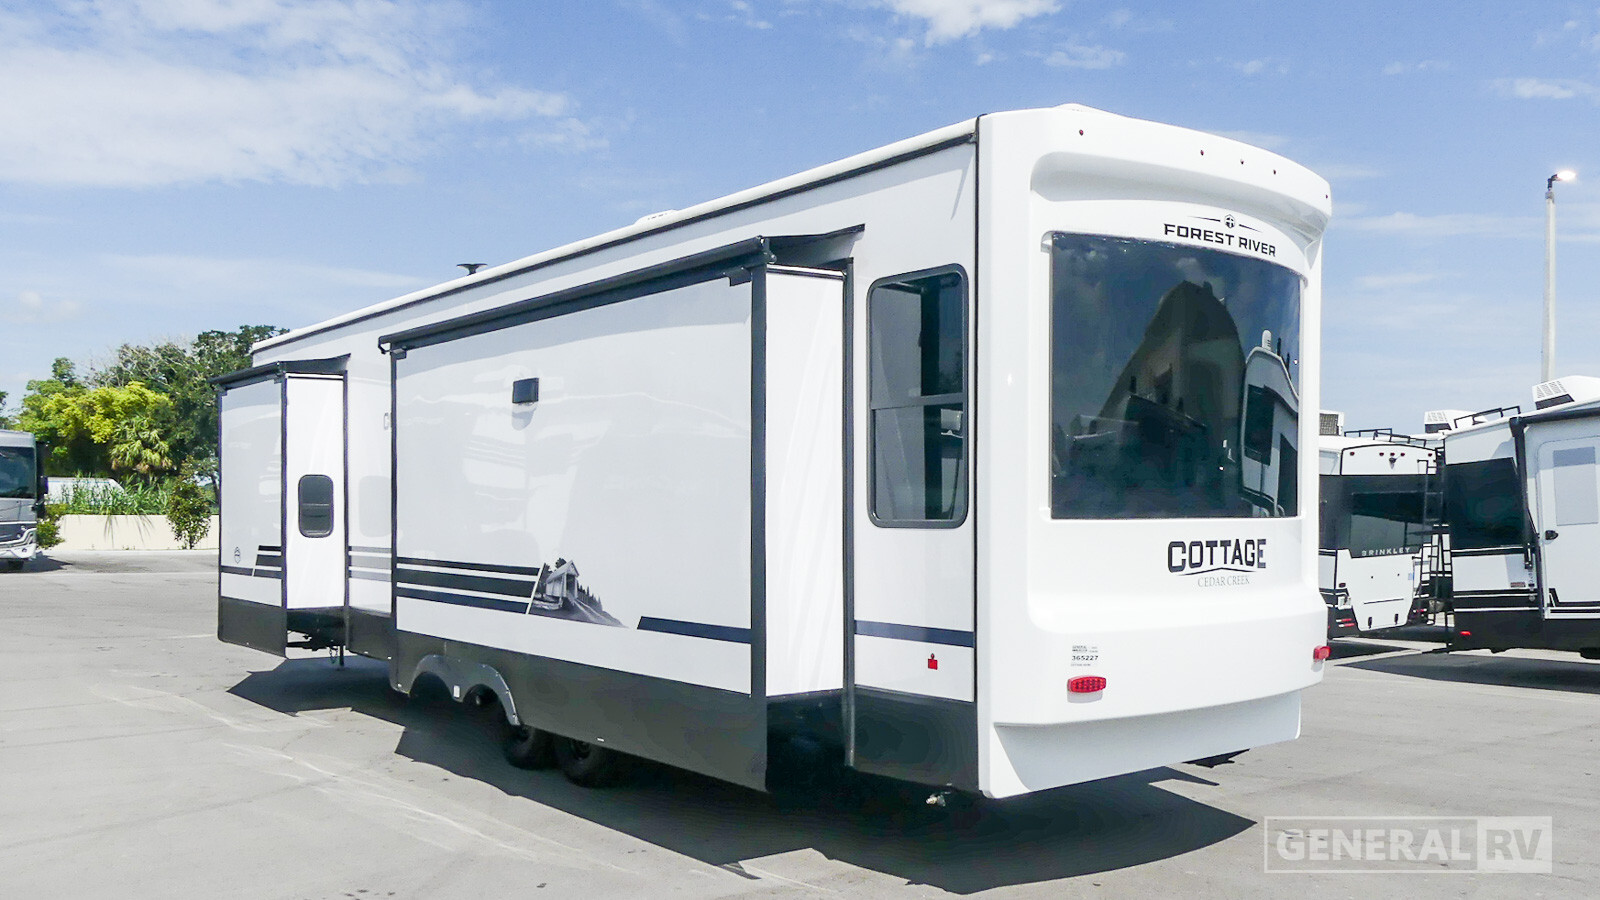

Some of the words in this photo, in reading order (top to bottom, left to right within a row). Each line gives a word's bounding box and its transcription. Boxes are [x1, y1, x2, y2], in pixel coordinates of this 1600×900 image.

[1163, 223, 1235, 246] FOREST
[1238, 236, 1276, 257] RIVER
[1167, 538, 1267, 573] COTTAGE
[1361, 547, 1410, 557] BRINKLEY
[1197, 576, 1226, 588] CEDAR
[1226, 575, 1250, 586] CREEK
